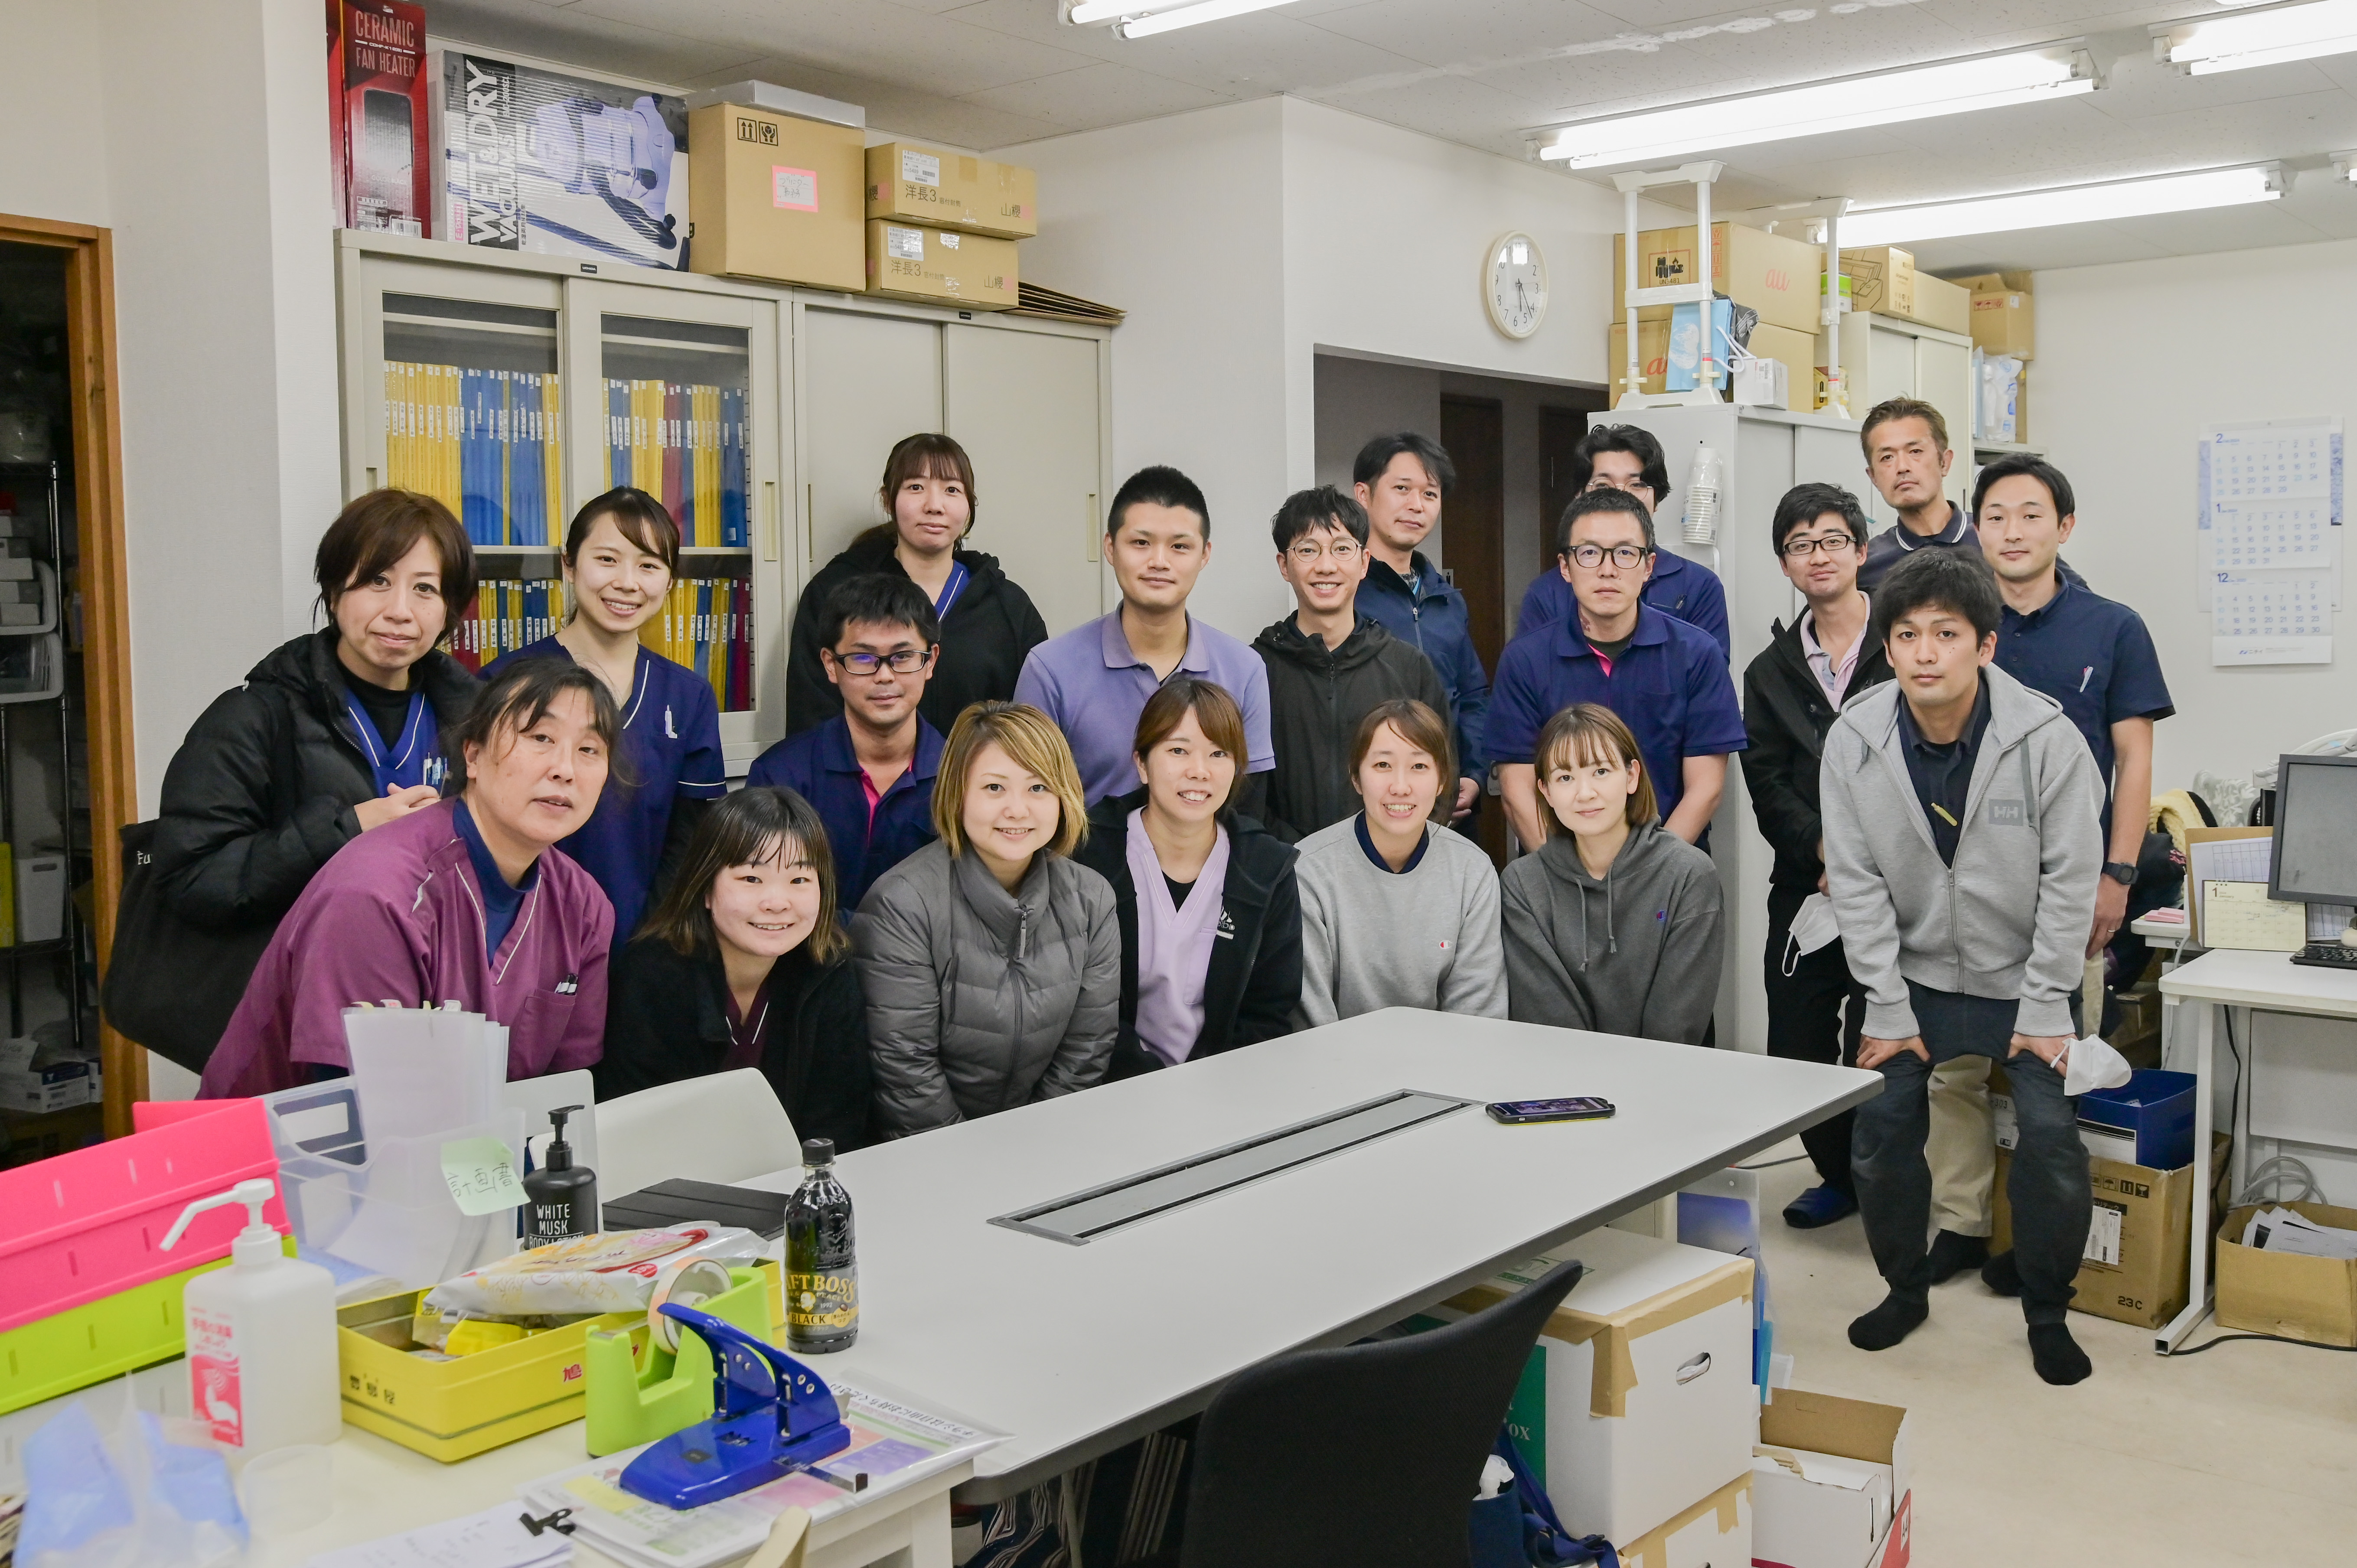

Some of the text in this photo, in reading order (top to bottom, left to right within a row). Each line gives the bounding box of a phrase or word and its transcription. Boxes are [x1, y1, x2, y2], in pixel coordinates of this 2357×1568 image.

[355, 10, 414, 48] CERAMIC
[356, 47, 416, 78] FAN HEATER
[466, 59, 498, 142] DRY
[499, 133, 518, 243] VACUUMS
[905, 184, 937, 202] 洋長3
[468, 152, 500, 244] WET
[891, 259, 921, 277] 洋長3
[1532, 264, 1537, 276] 2
[1535, 283, 1539, 294] 3
[1765, 269, 1790, 292] au
[1497, 294, 1501, 306] 8
[1530, 302, 1535, 313] 4
[1504, 309, 1509, 321] 7
[1513, 315, 1518, 327] 6
[1523, 312, 1527, 324] 5
[2216, 434, 2223, 443] 2
[2217, 503, 2220, 512] 1
[2217, 573, 2228, 582] 12
[2212, 887, 2217, 897] 1
[447, 1162, 512, 1197] 計画書
[536, 1203, 571, 1219] WHITE
[539, 1219, 568, 1235] MUSK
[813, 1274, 855, 1304] BOSS
[2117, 1295, 2143, 1311] 23C
[791, 1313, 826, 1325] BLACK
